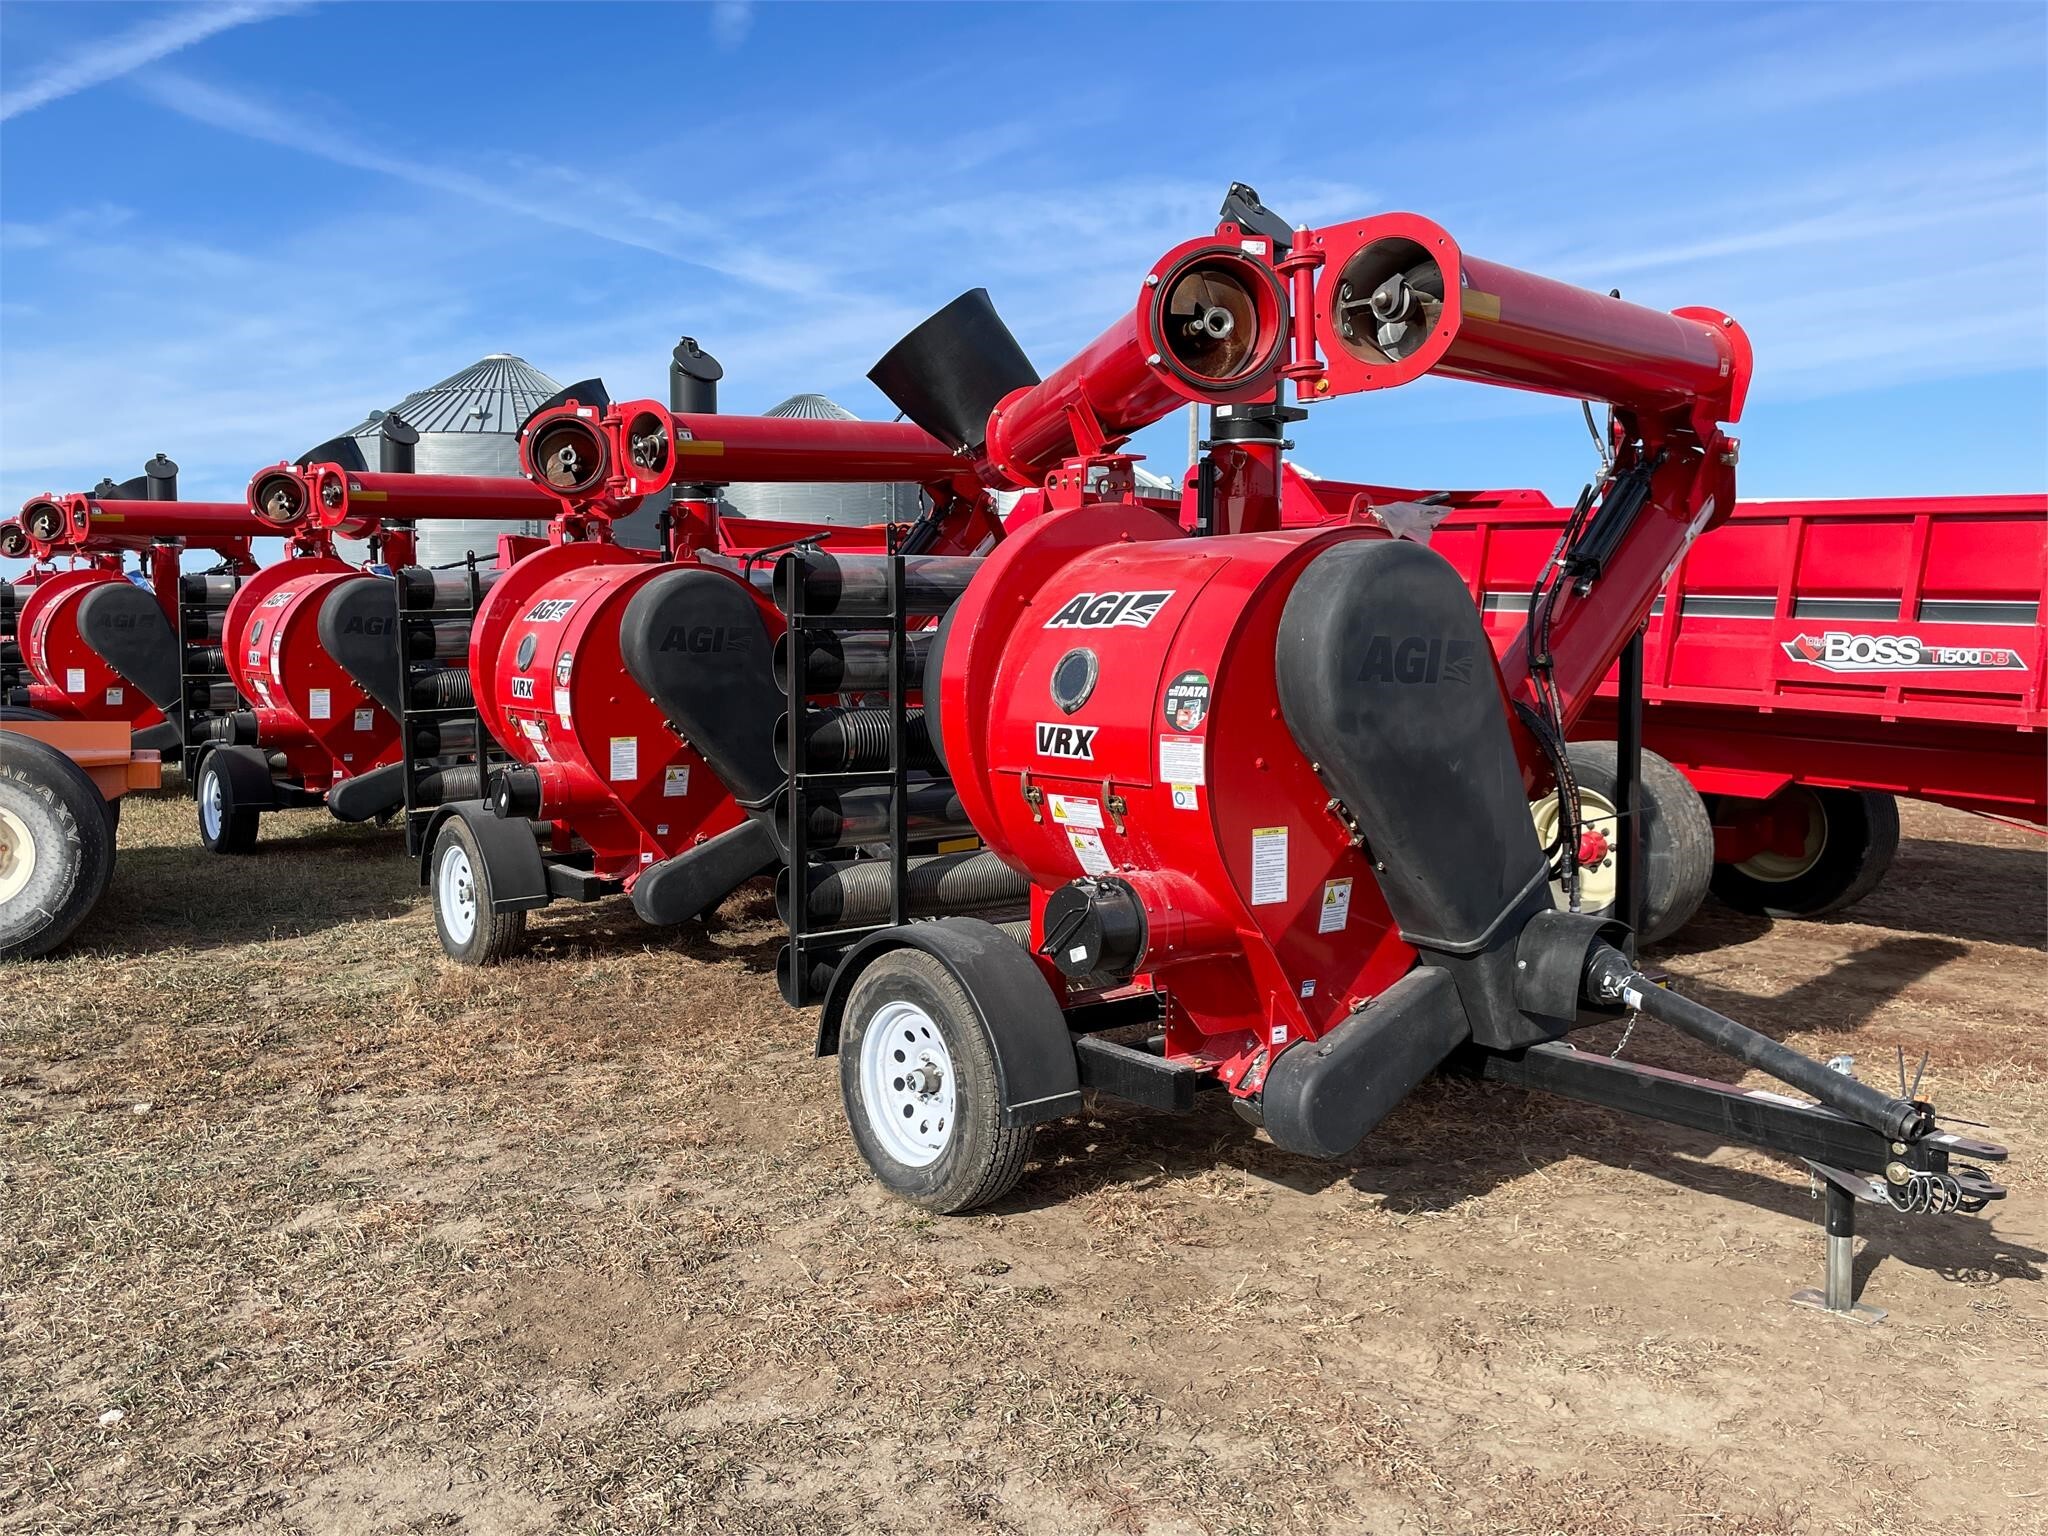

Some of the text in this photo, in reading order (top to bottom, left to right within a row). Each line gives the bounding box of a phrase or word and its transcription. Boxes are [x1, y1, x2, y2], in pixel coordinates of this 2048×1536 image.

[526, 601, 562, 620] AGI
[1048, 593, 1136, 626] AGI
[343, 615, 394, 635] AGI
[660, 625, 725, 653] AGI
[1357, 635, 1441, 684] AGI
[1825, 632, 1921, 665] BOSS
[1928, 649, 2010, 665] T1500DB
[513, 679, 533, 697] VRX
[1178, 686, 1208, 698] DATA
[1038, 726, 1094, 757] VRX
